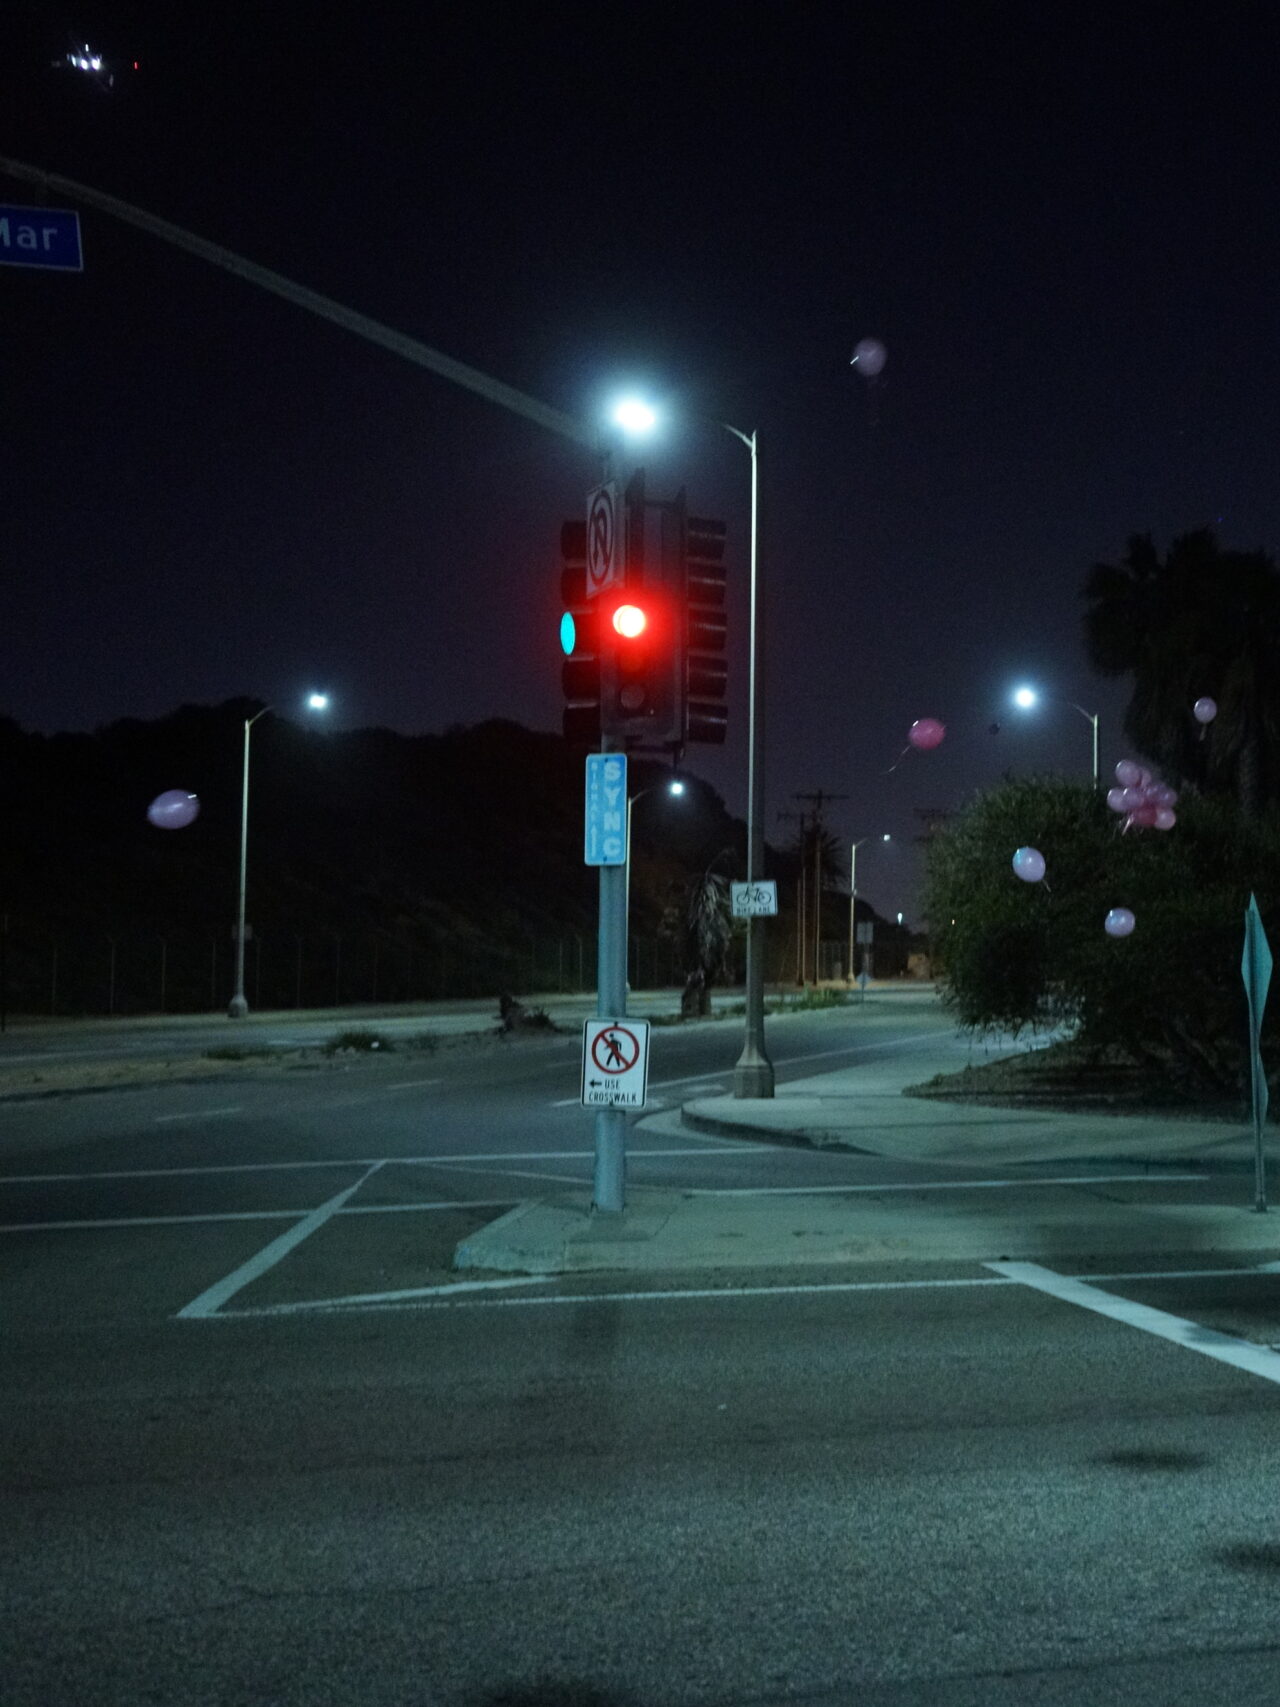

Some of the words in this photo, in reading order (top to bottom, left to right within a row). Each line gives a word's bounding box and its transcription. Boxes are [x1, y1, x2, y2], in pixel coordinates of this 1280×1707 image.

[603, 761, 621, 856] SYNC
[604, 1079, 620, 1090] USE
[588, 1091, 637, 1103] CROSSWALK
